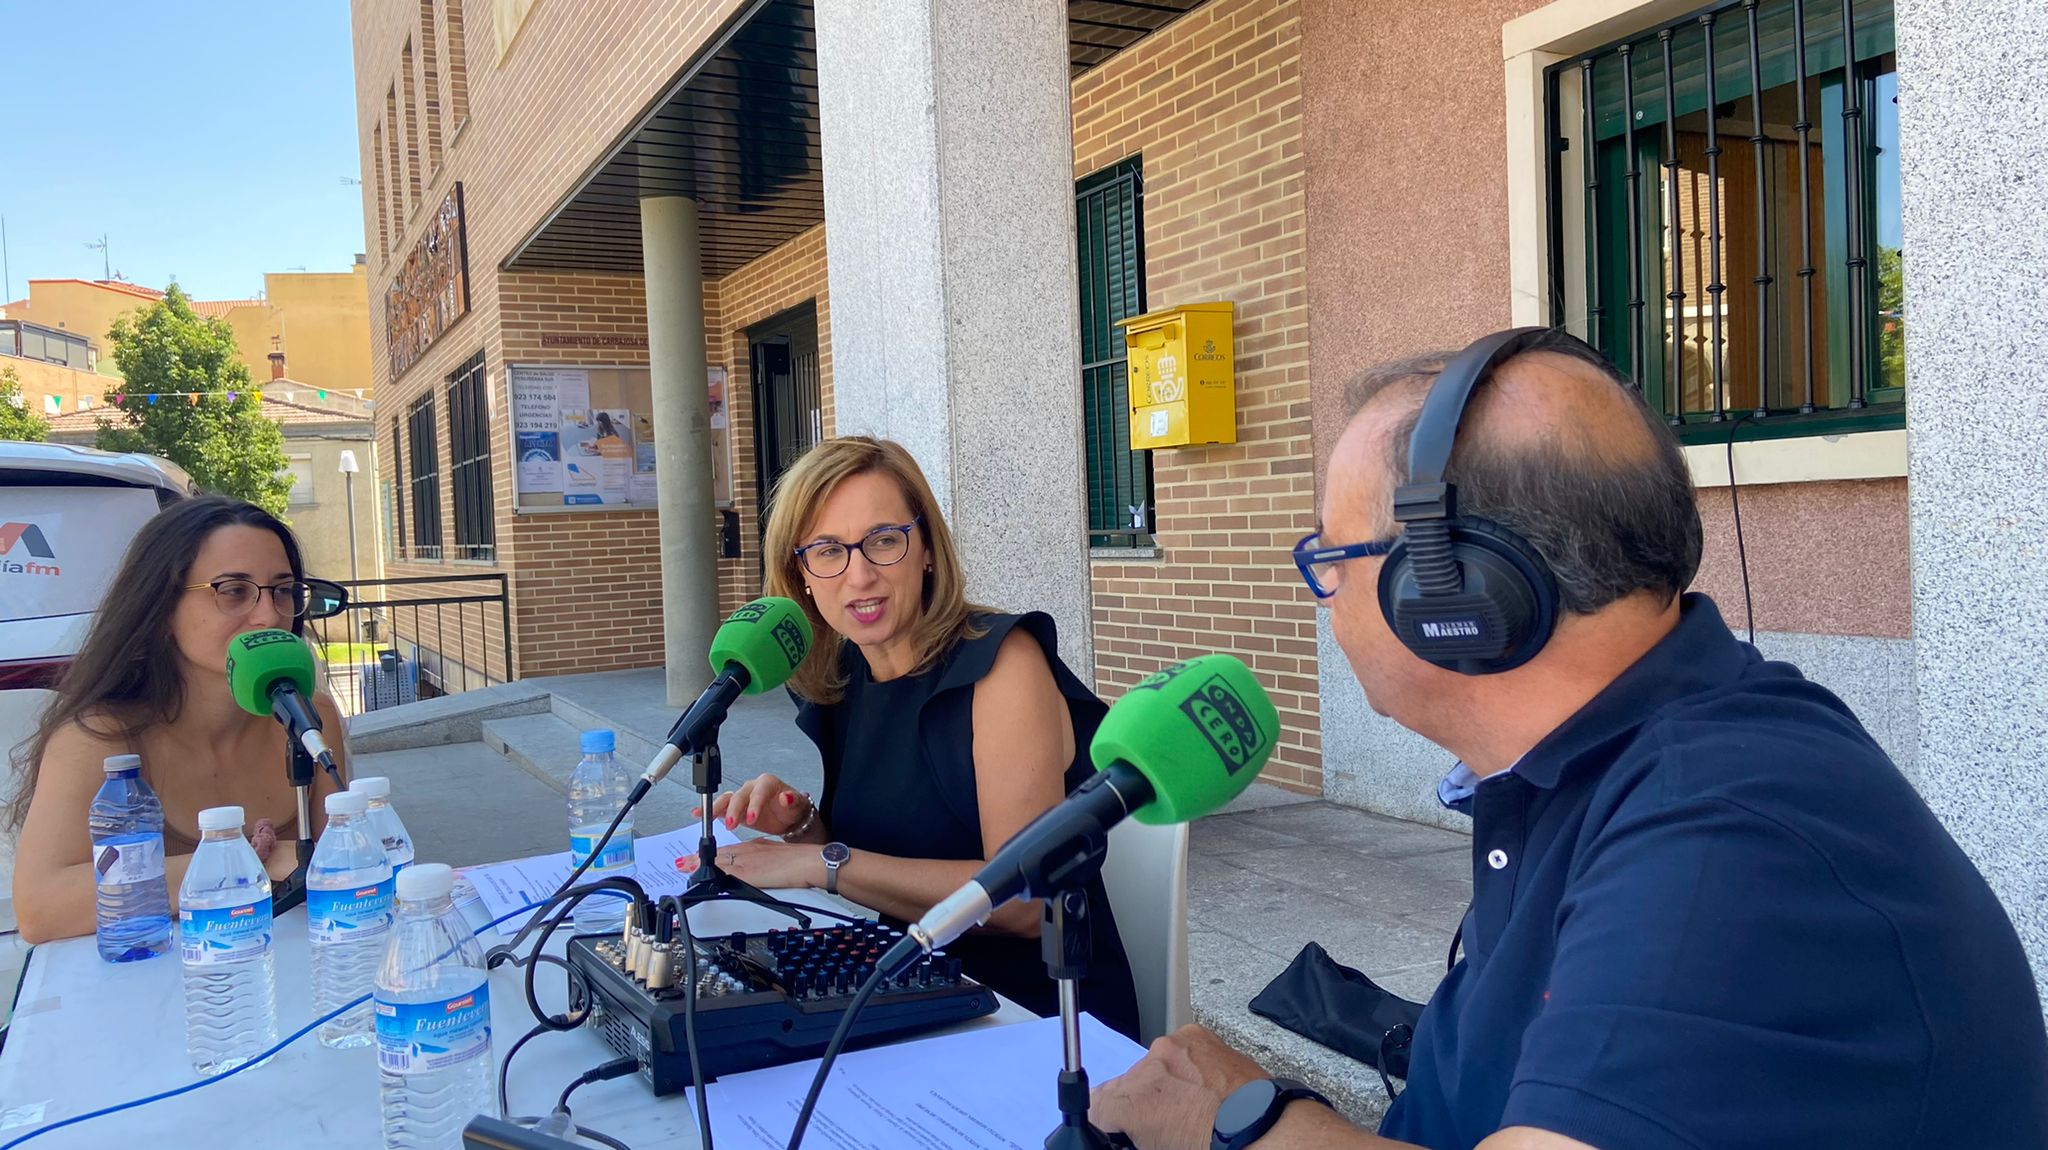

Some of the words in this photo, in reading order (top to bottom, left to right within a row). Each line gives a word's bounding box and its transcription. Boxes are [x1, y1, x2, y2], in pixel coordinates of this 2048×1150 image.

[543, 335, 591, 345] AYUNTAMIENTO
[592, 336, 601, 345] DE
[1194, 352, 1226, 361] CORREOS
[1421, 622, 1479, 638] MAESTRO
[1214, 689, 1253, 743] ONDA
[1200, 706, 1240, 756] CERO
